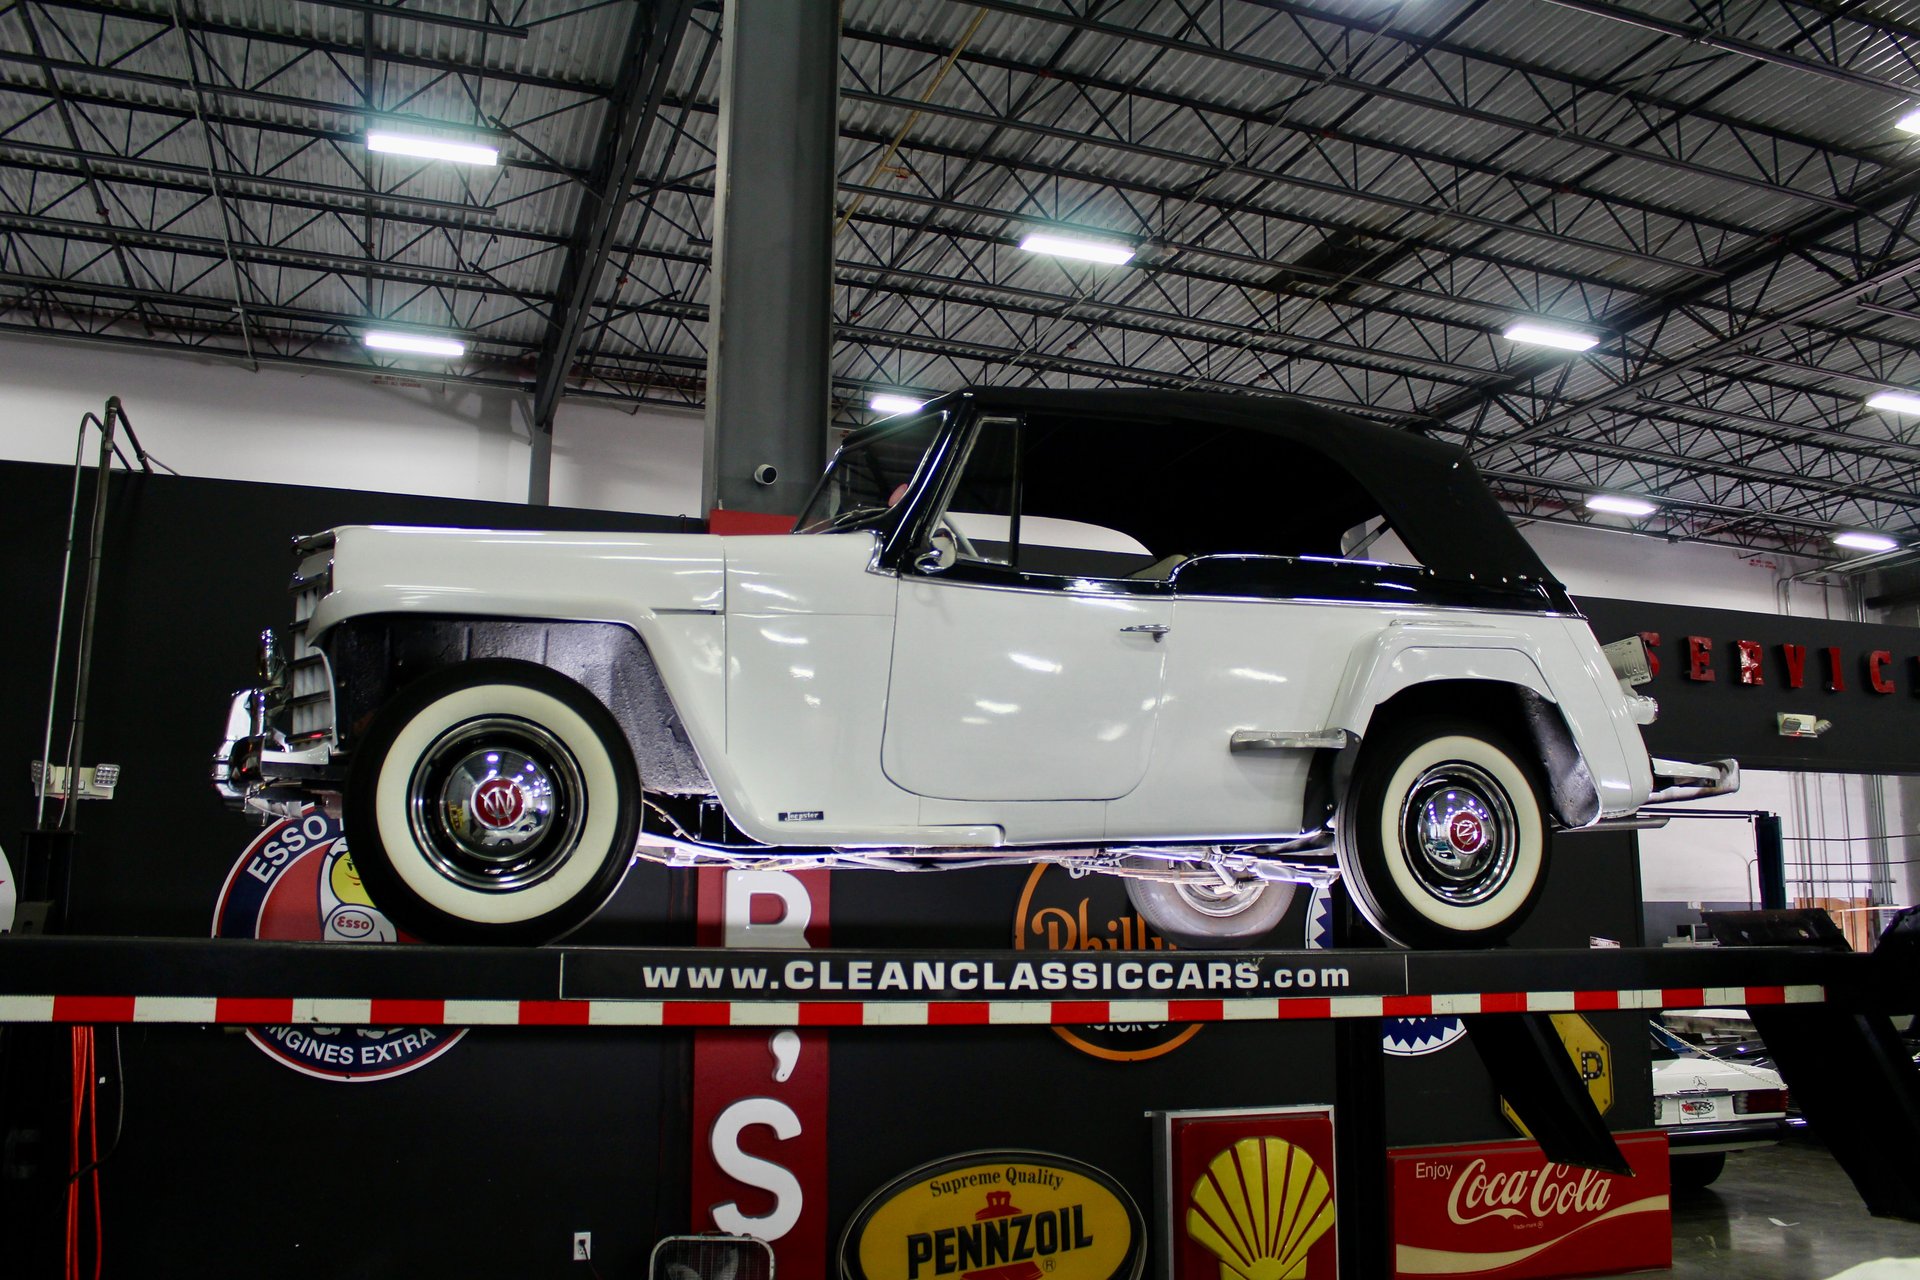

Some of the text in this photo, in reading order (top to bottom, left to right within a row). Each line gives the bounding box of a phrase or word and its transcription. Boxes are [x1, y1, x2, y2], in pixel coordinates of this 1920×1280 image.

[1639, 631, 1920, 693] SERVIC
[247, 815, 328, 884] ESSO
[337, 916, 370, 930] Esso
[642, 960, 1350, 991] www.CLEANCLASSICCARS.com
[265, 1026, 437, 1065] NGINES EXTRA
[930, 1166, 1064, 1197] Supreme Quality
[1416, 1161, 1453, 1180] Enjoy
[1447, 1158, 1612, 1225] Coca-Cola
[907, 1204, 1094, 1280] PENNZOIL
